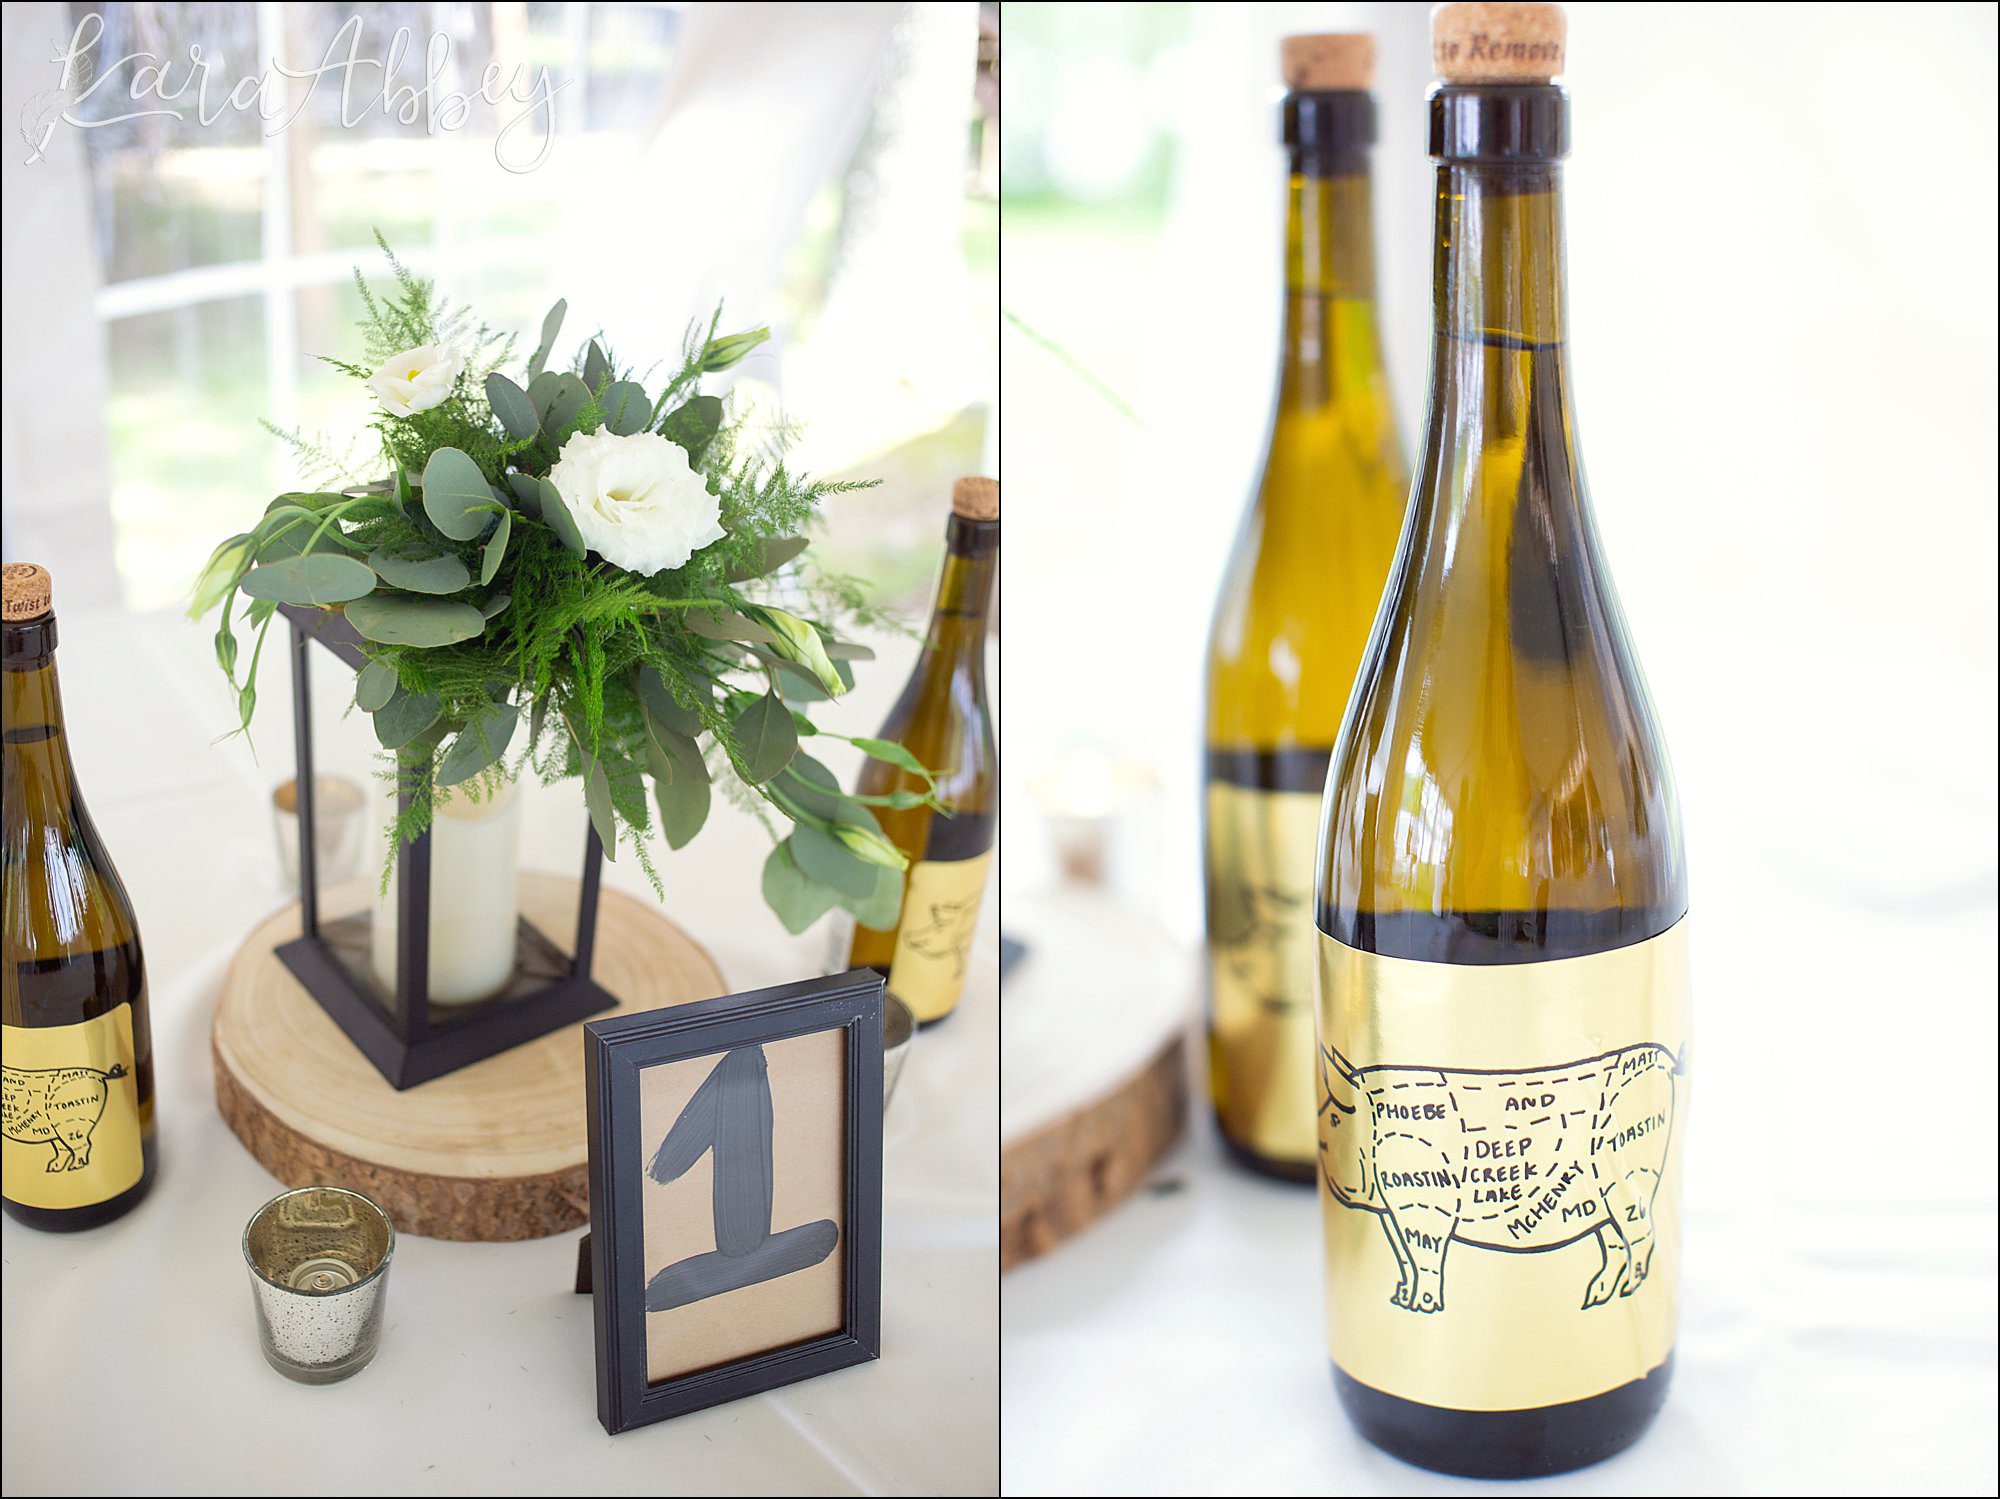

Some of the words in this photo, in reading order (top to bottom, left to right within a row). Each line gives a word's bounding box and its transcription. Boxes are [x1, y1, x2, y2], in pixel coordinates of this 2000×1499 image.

[5, 598, 40, 613] Twist
[1623, 1050, 1660, 1075] MATT
[3, 1077, 25, 1086] AND
[1376, 1103, 1447, 1120] PHOEBE
[1505, 1093, 1556, 1111] AND
[32, 1127, 50, 1135] MD
[1607, 1108, 1666, 1152] TOASTIN
[1475, 1137, 1532, 1159] DEEP
[645, 1043, 839, 1313] 1
[1380, 1169, 1451, 1190] ROASTIN
[1470, 1161, 1539, 1183] CREEK
[1473, 1184, 1524, 1204] LAKE
[1561, 1199, 1597, 1223] MD
[1404, 1228, 1443, 1253] MAY
